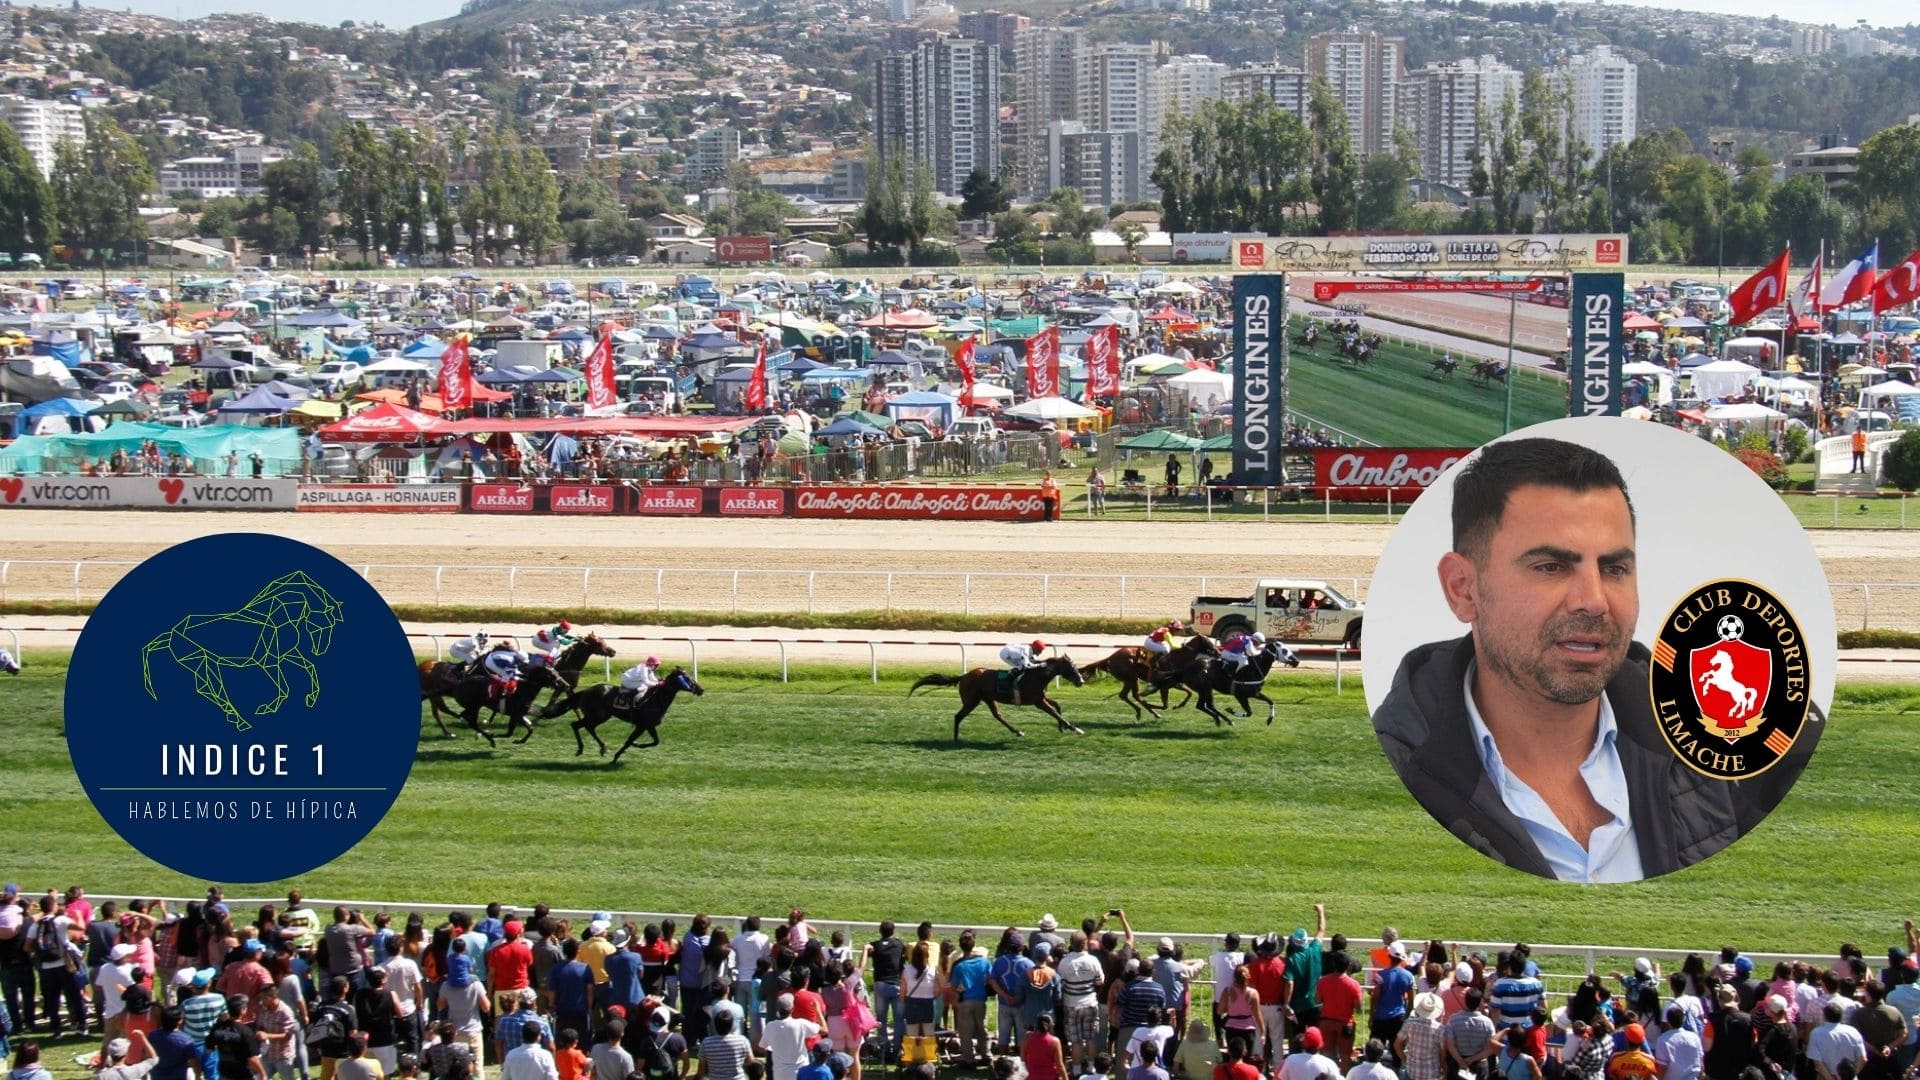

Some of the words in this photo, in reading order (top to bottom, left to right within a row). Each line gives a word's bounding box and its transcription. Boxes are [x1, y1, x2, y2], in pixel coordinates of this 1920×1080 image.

[1369, 242, 1417, 253] DOMINGO
[1418, 242, 1432, 252] 07
[1462, 243, 1499, 252] ETAPA
[1363, 253, 1406, 262] FEBRERO
[1415, 253, 1440, 262] 2016
[1447, 253, 1470, 261] DOBLE
[1472, 253, 1481, 261] DE
[1482, 253, 1499, 261] ORO
[1245, 294, 1270, 471] LONGINES
[32, 482, 110, 500] vtr.com
[193, 484, 272, 502] vtr.com
[301, 491, 373, 503] ASPILLAGA
[384, 491, 457, 503] HORNAUER
[477, 495, 528, 506] AKBAR
[557, 496, 607, 507] AKBAR
[644, 497, 696, 508] AKBAR
[726, 498, 778, 510] AKBAR
